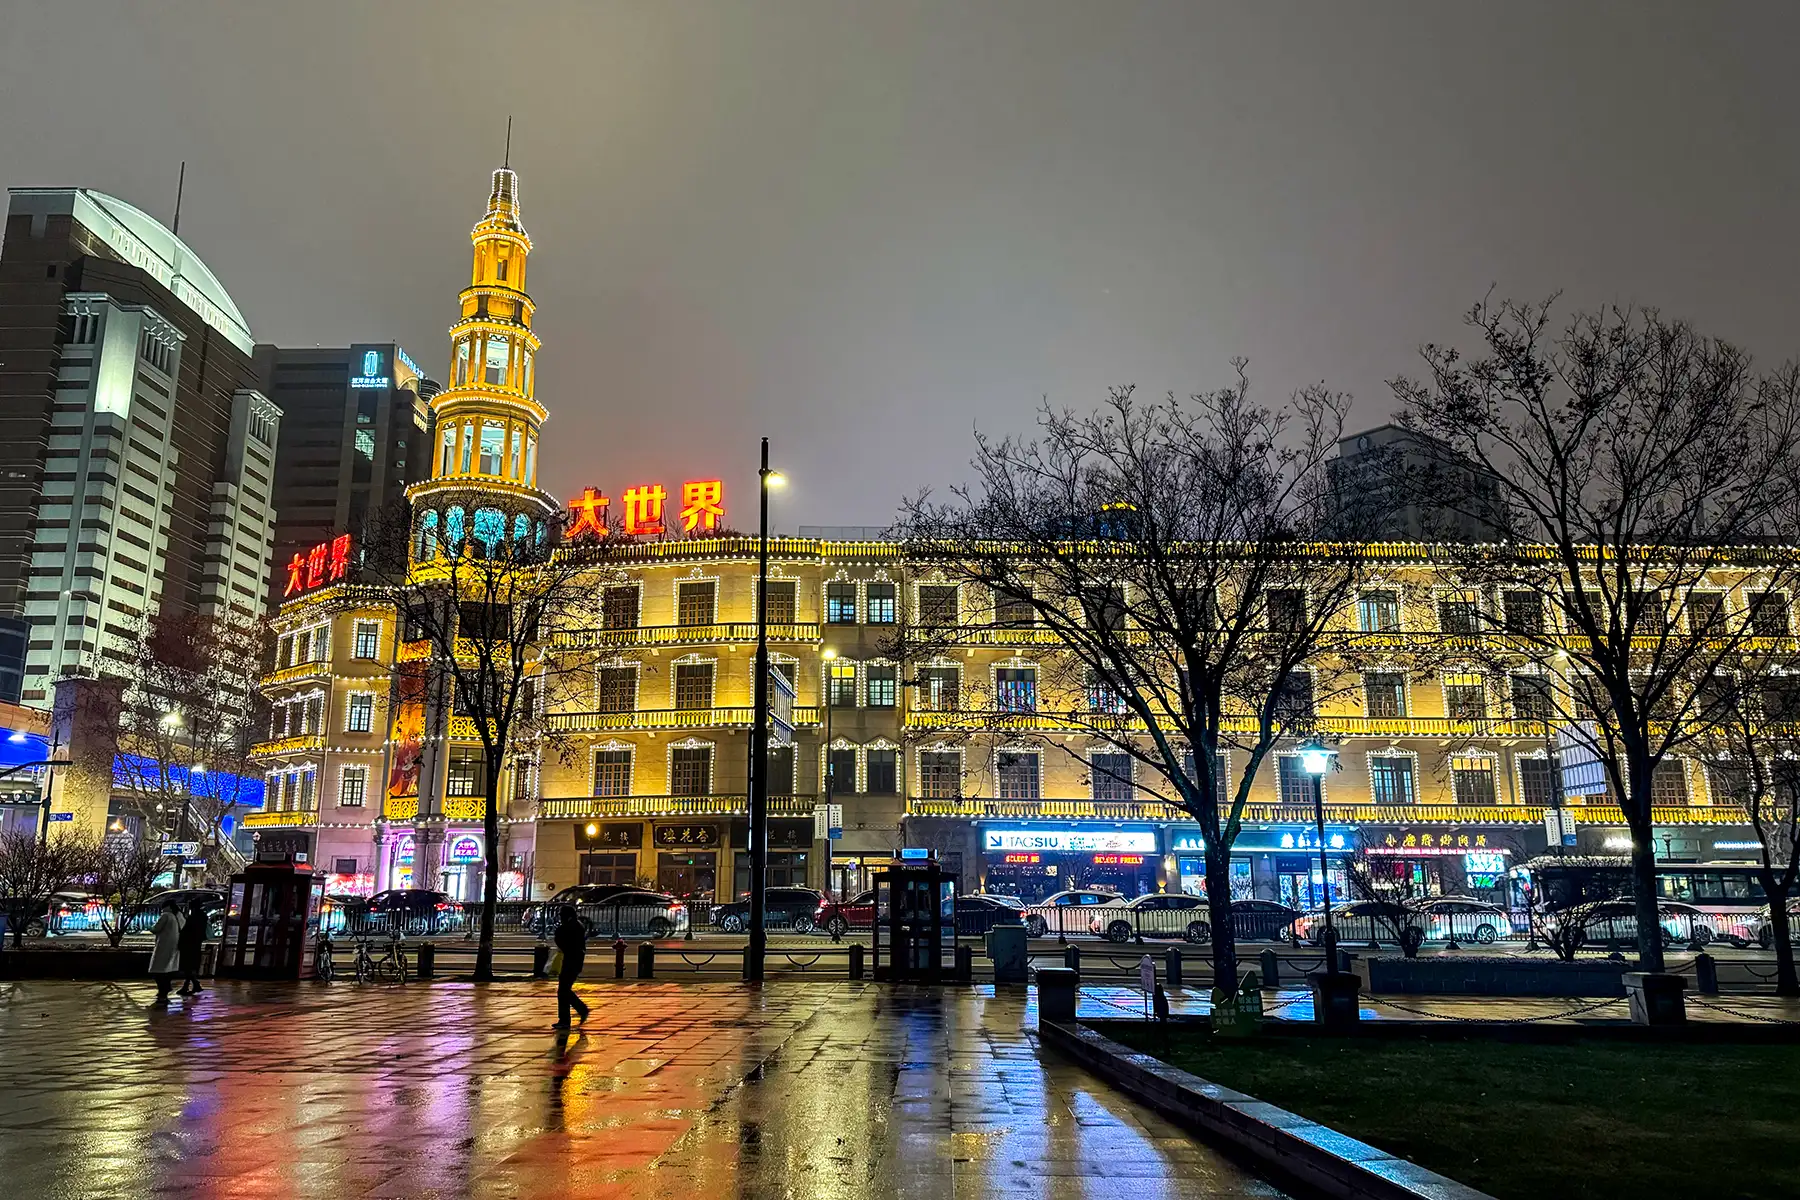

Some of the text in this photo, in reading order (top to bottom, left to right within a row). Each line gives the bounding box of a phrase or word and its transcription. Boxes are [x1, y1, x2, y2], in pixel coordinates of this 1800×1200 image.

[566, 480, 725, 538] 大世界
[284, 533, 351, 598] 大世界
